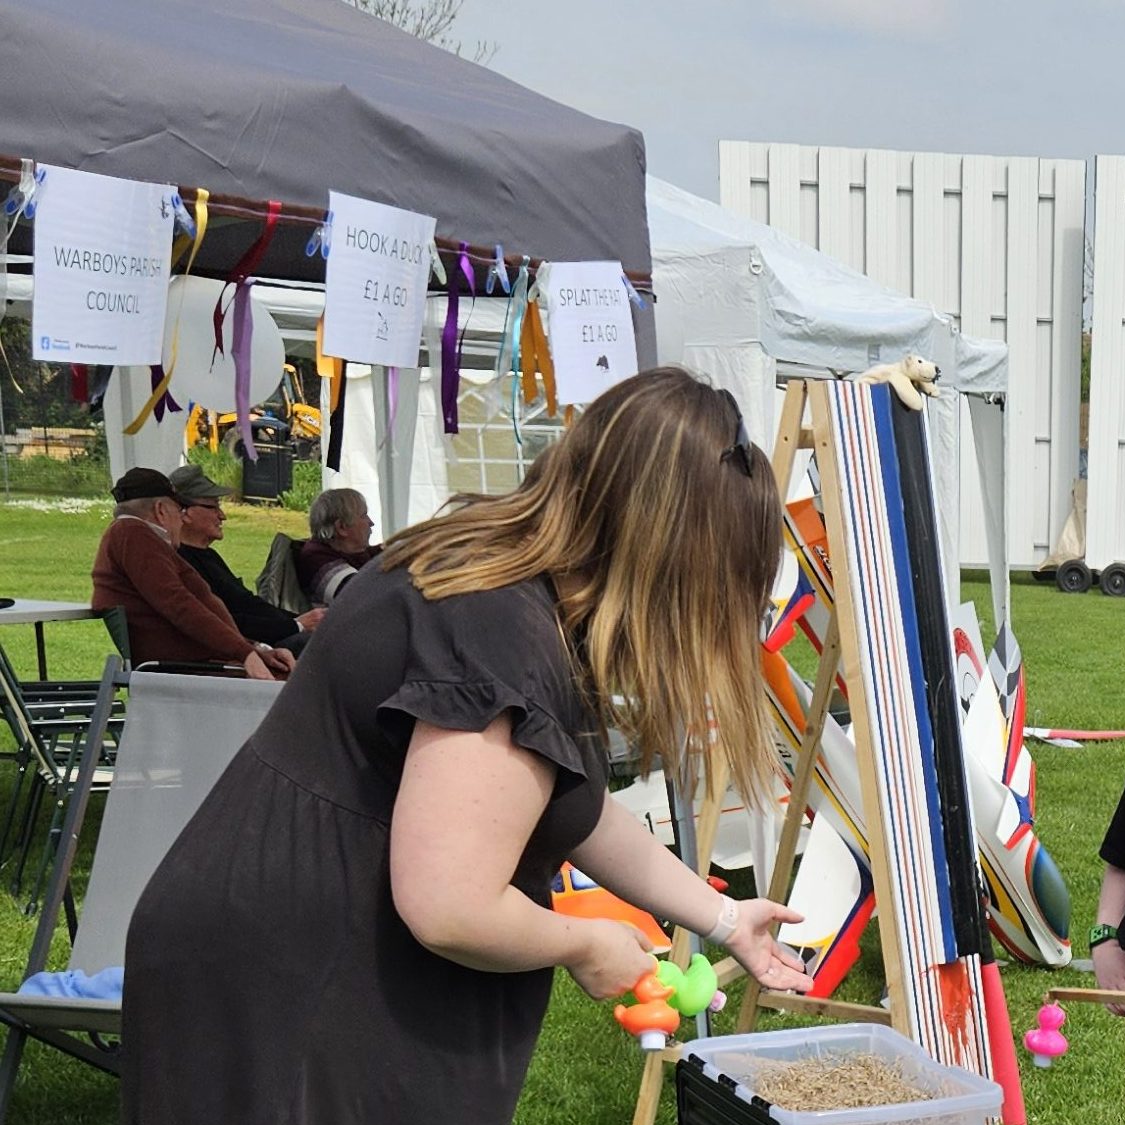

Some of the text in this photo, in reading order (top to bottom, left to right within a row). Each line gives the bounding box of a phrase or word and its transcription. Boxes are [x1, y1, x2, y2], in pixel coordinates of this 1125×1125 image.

[346, 225, 424, 264] HOOK A DUCK
[54, 246, 161, 278] WARBOYS PARISH
[86, 290, 140, 314] COUNCIL
[364, 279, 408, 308] £1 A GO
[560, 288, 591, 306] SPLAT
[582, 324, 618, 342] £1 A GO
